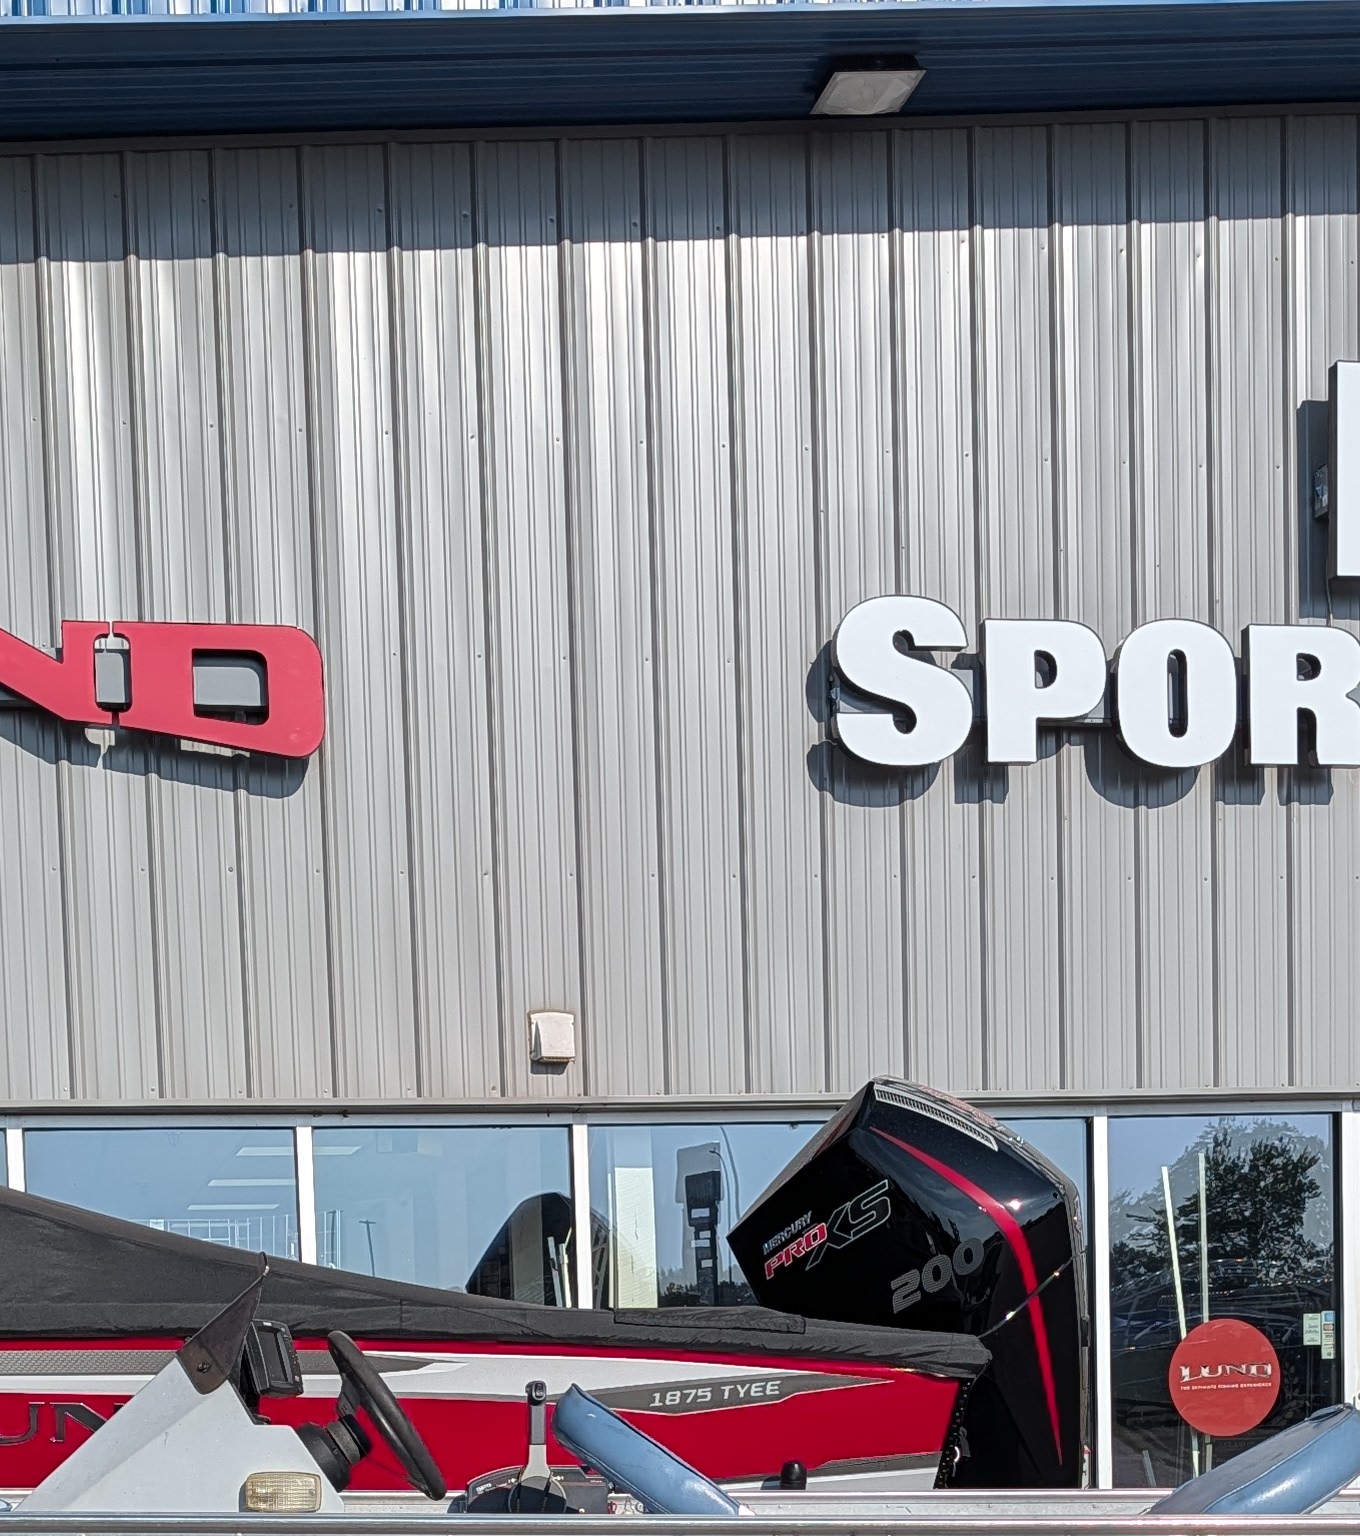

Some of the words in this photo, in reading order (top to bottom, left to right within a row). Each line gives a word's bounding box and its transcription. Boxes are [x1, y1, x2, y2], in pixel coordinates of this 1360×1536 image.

[762, 1209, 813, 1256] MERCURY
[890, 1237, 986, 1314] 200
[1180, 1363, 1273, 1383] LUND
[649, 1387, 712, 1407] 1875
[720, 1380, 782, 1400] TYEE
